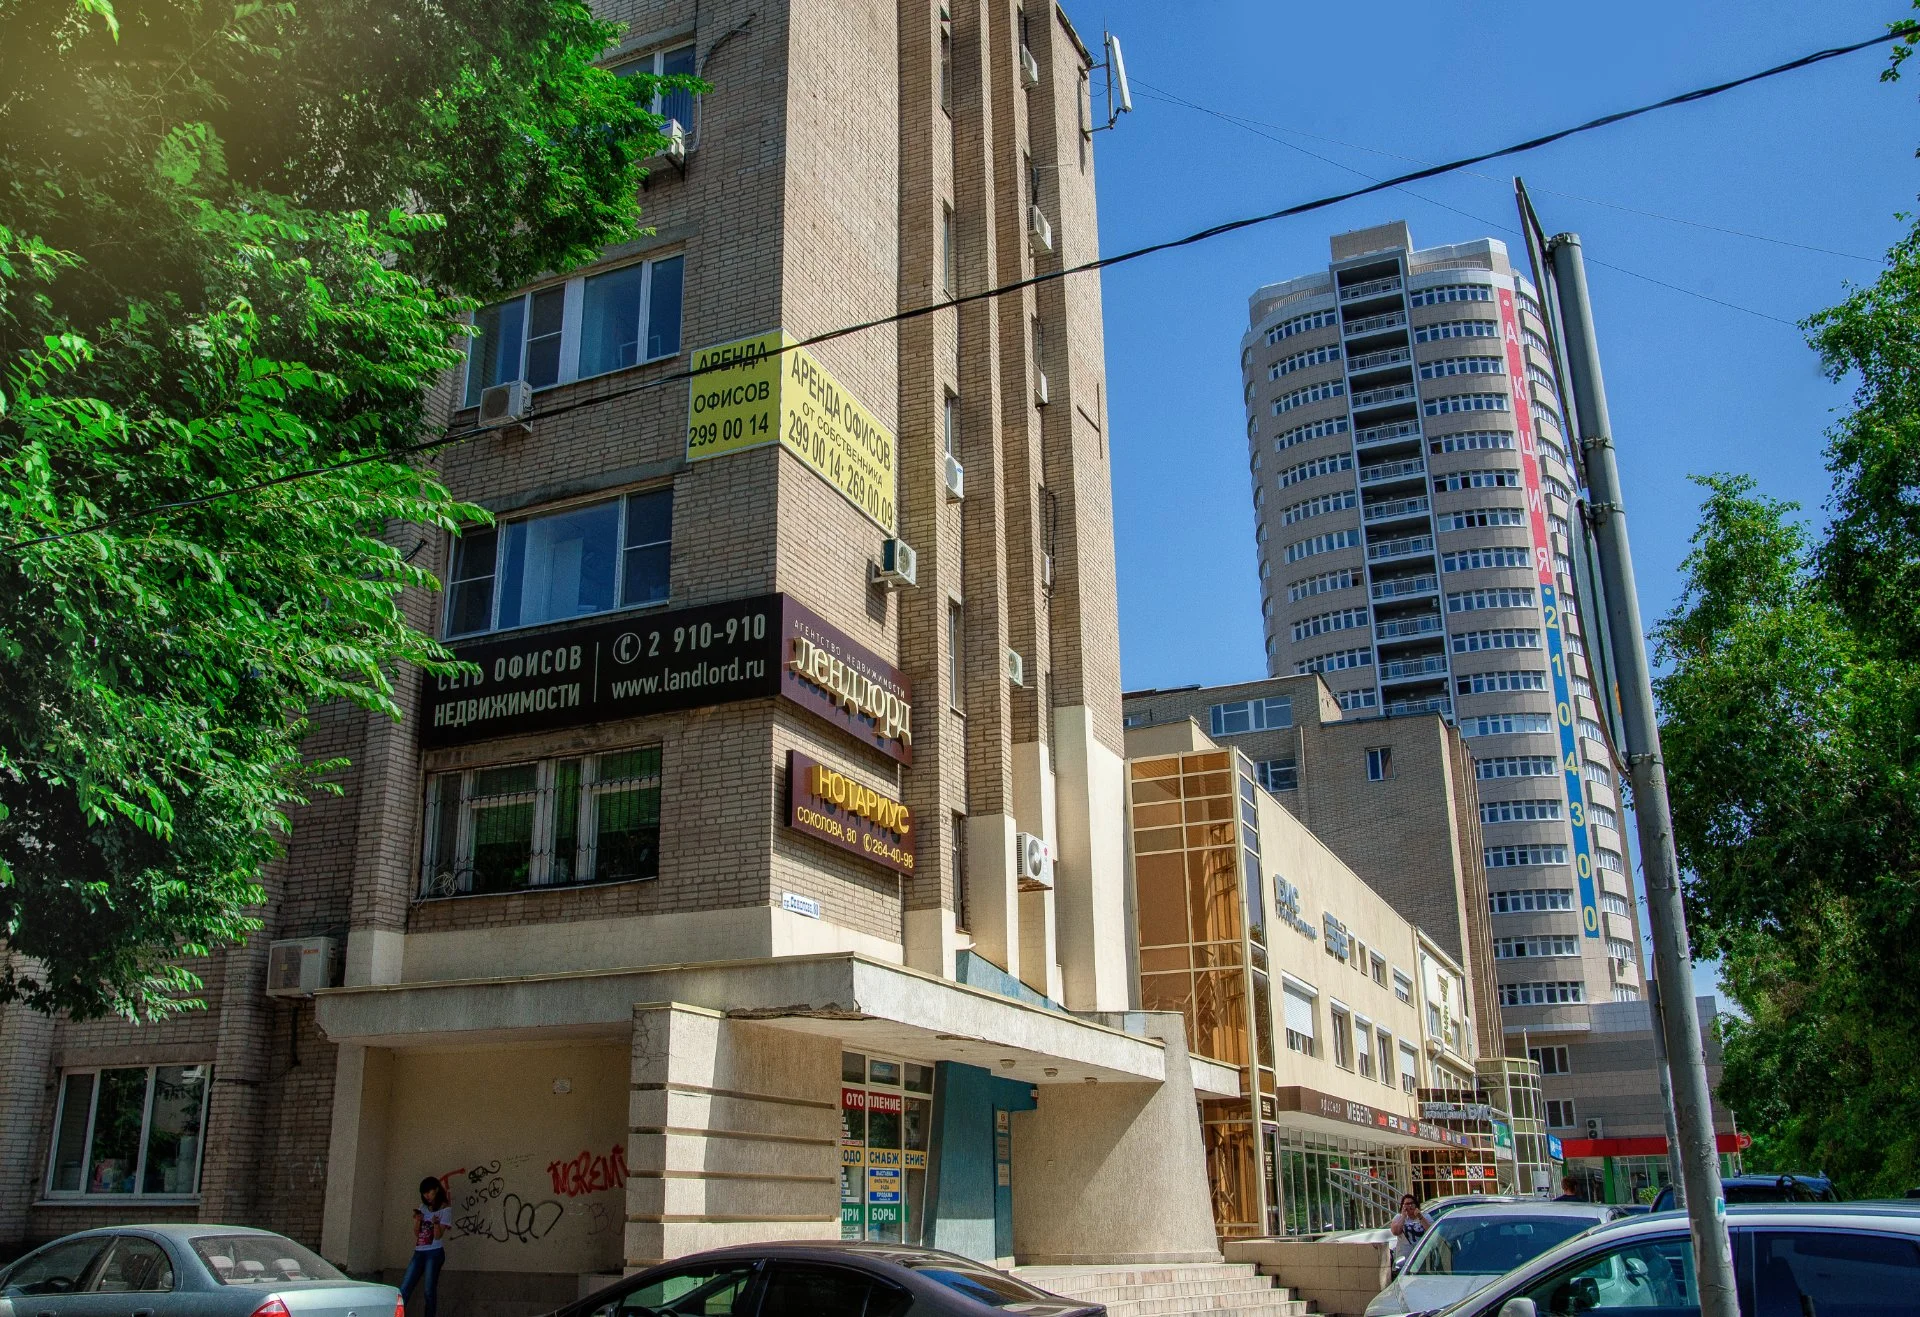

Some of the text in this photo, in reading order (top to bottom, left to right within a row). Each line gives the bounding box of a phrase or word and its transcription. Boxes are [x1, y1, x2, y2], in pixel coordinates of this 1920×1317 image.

[699, 341, 768, 374] АРЕНДА
[694, 380, 770, 414] ОФИСОВ
[791, 351, 891, 471] АРЕНДА ОФИСОВ
[688, 412, 769, 448] 299 00 14
[802, 402, 883, 488] ОТ СОБСТВЕННИКА
[1505, 321, 1550, 572] АКЦИЯ
[789, 410, 810, 454] 299
[812, 431, 826, 469] 00
[847, 466, 866, 508] 269
[867, 484, 879, 519] 00
[881, 497, 893, 531] 09
[673, 613, 766, 653] 910-910
[794, 619, 906, 699] АГЕНТСТВО НЕДВИЖИМОСТИ
[494, 645, 582, 683] ОФИСОВ
[611, 657, 766, 700] www.landlord.ru
[434, 683, 580, 728] НЕДВИЖИМОСТИ
[817, 765, 910, 834] НОТАРИУС
[797, 806, 914, 869] СОКОЛОВА, 80 264-40-98
